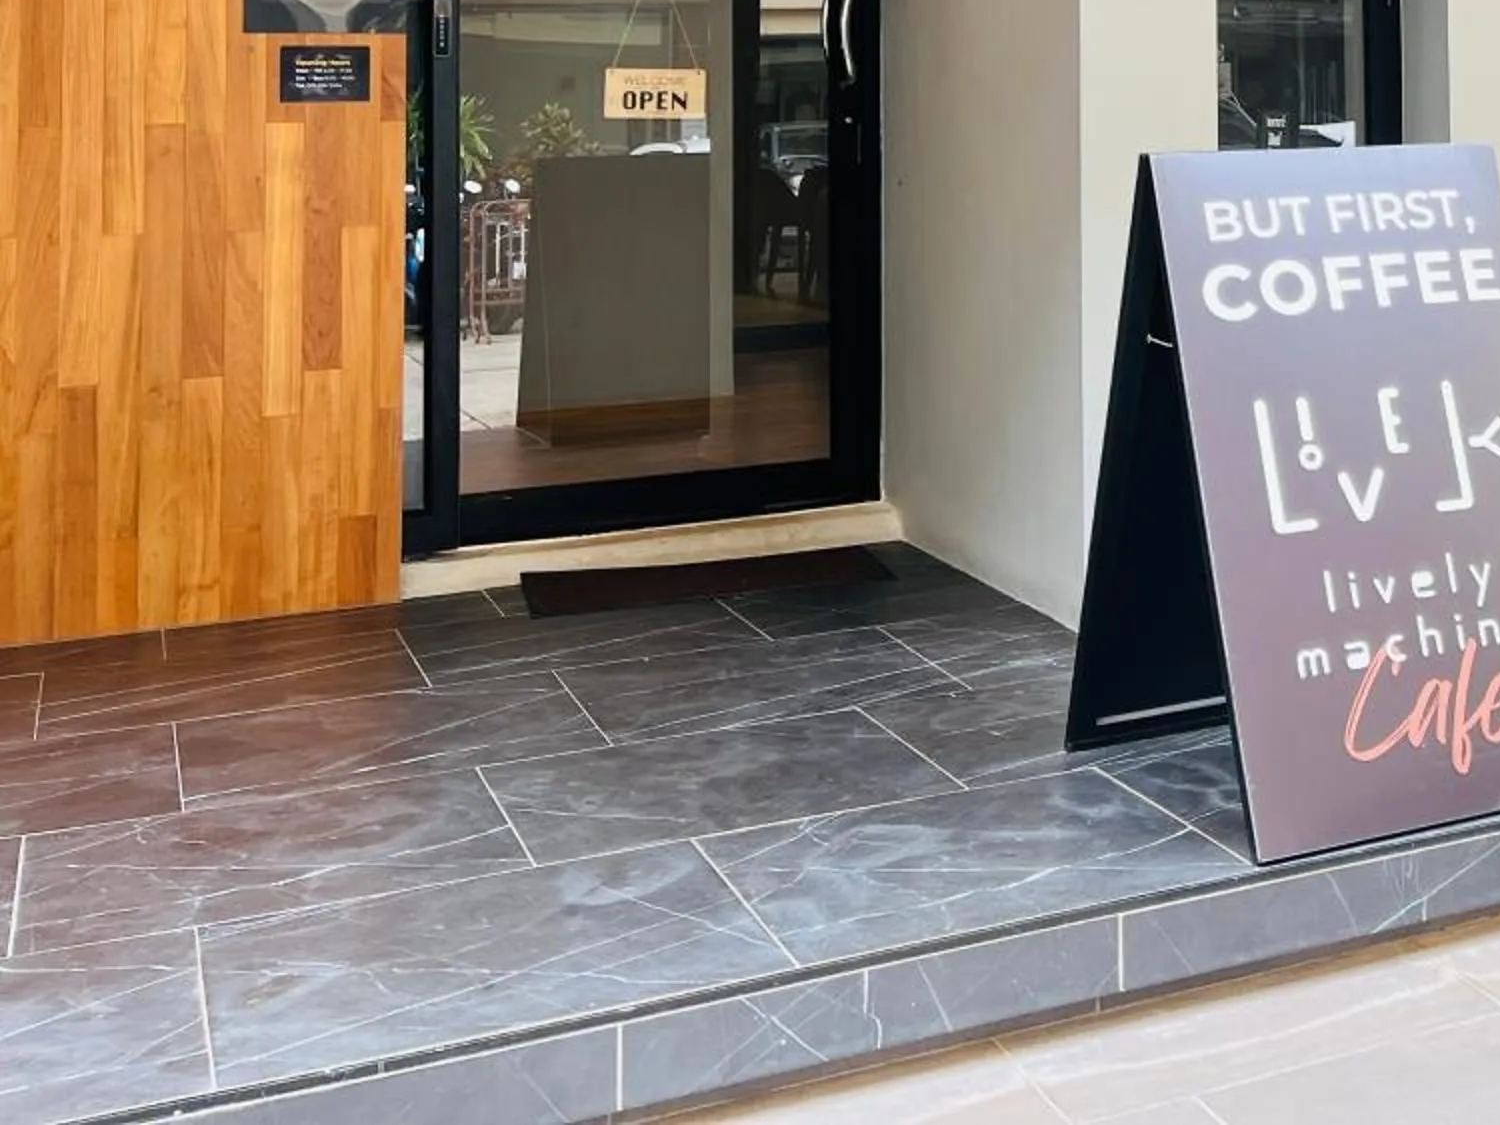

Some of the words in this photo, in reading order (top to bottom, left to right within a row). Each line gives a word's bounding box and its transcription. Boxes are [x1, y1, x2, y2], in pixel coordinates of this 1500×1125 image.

[623, 90, 688, 111] OPEN
[1203, 196, 1311, 242] BUT
[1325, 189, 1476, 235] FIRST,
[1323, 552, 1491, 613] lively
